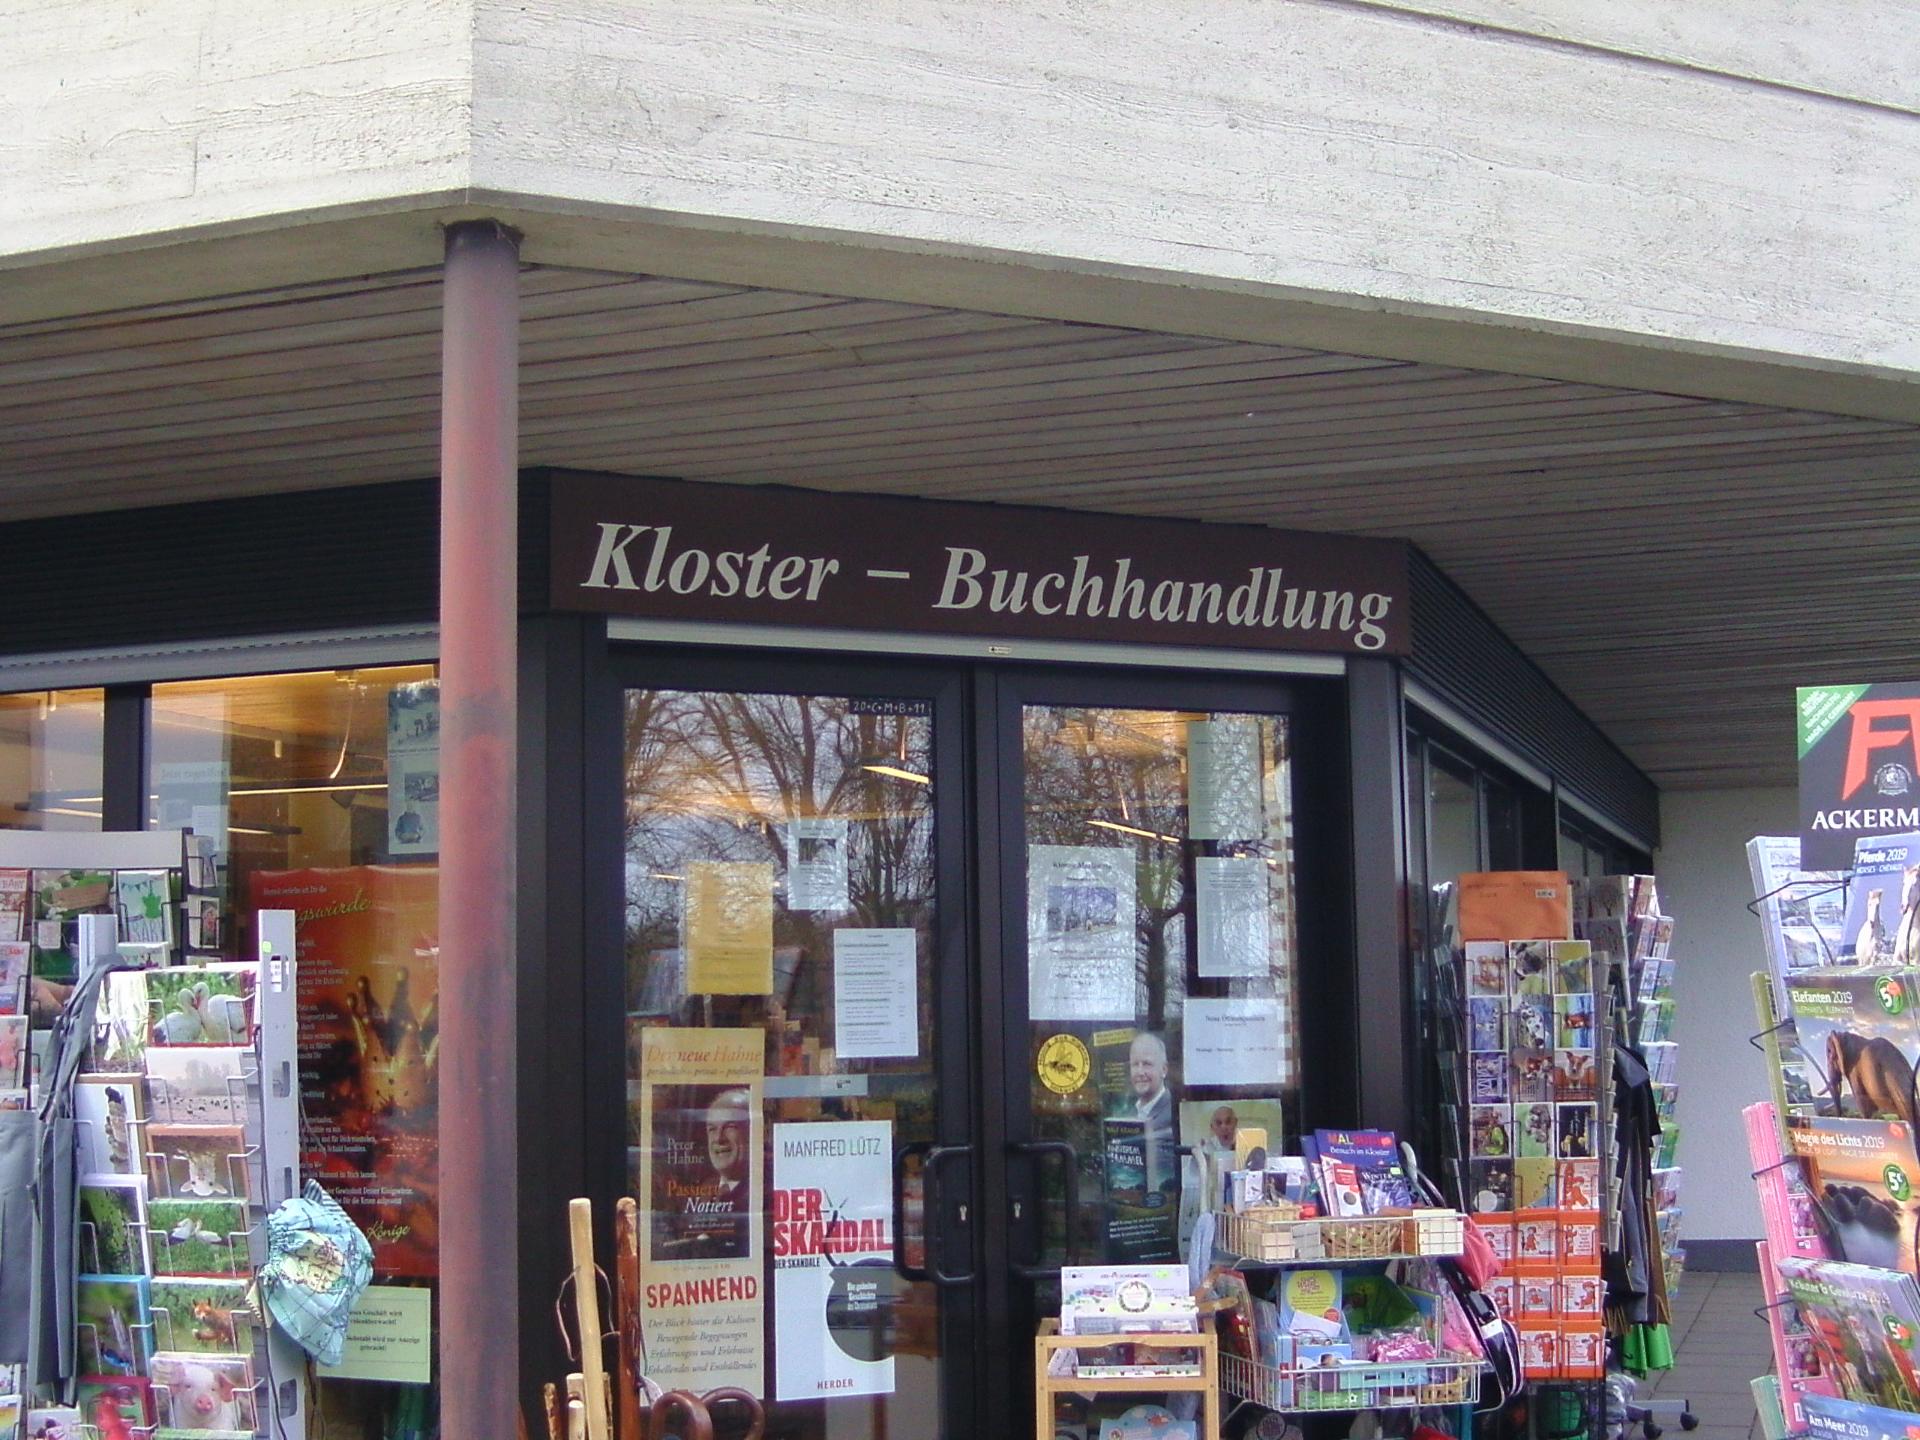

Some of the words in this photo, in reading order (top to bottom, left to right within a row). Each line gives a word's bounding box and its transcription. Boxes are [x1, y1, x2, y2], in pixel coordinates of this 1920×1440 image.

[580, 522, 839, 603] Kloster
[932, 546, 1394, 652] Buchhandlung
[1858, 851, 1886, 864] Pferde
[1886, 848, 1908, 862] 2019
[1791, 990, 1831, 1004] Elefanten
[1831, 991, 1853, 1004] 2019
[678, 1049, 711, 1063] neue
[713, 1045, 761, 1063] Hahne
[667, 1138, 695, 1151] Peter
[784, 1139, 846, 1158] MANFRED
[850, 1137, 881, 1156] LÜTZ
[1794, 1131, 1820, 1147] Magie
[1820, 1133, 1836, 1145] des
[1836, 1134, 1862, 1147] Lichts
[1862, 1135, 1885, 1148] 2019
[667, 1151, 705, 1165] Hahne
[667, 1180, 720, 1196] Passiert
[684, 1196, 735, 1214] Notiert
[774, 1188, 823, 1222] DER
[366, 1219, 411, 1243] Könige
[774, 1218, 894, 1256] SKANDAL
[774, 1259, 786, 1269] DER
[788, 1257, 820, 1269] SKANDALE
[646, 1275, 757, 1309] SPANNEND
[817, 1379, 854, 1390] HERDER
[1809, 1415, 1823, 1427] Am
[1823, 1417, 1847, 1433] Meer
[1847, 1423, 1869, 1437] 2019
